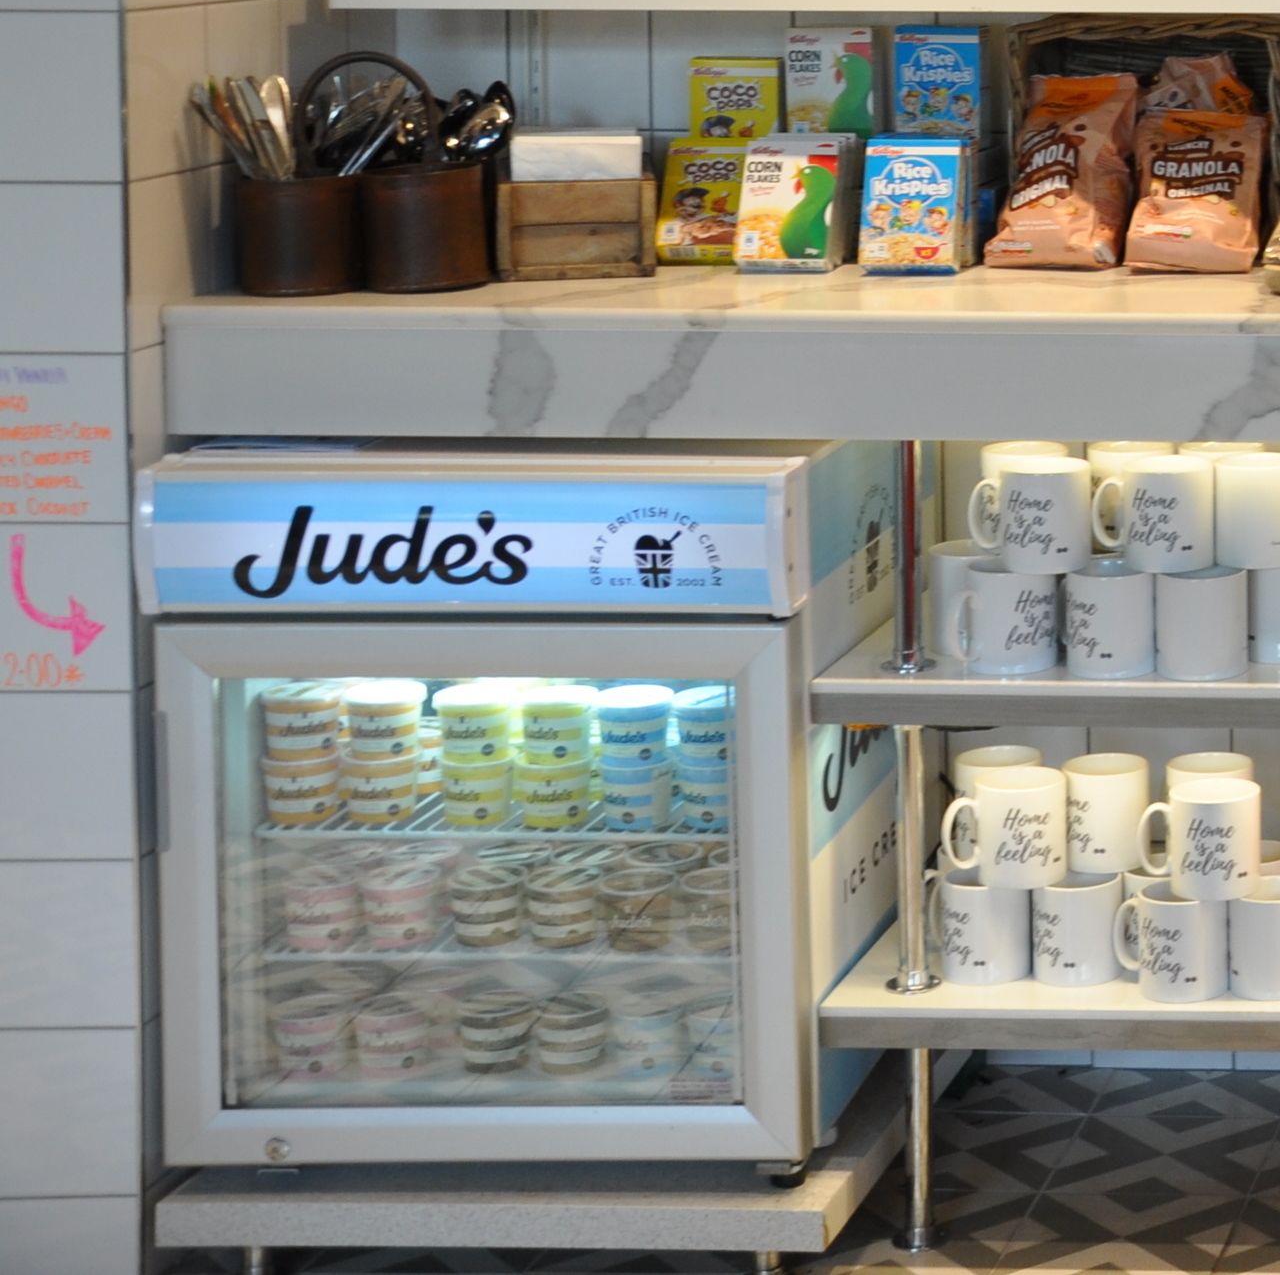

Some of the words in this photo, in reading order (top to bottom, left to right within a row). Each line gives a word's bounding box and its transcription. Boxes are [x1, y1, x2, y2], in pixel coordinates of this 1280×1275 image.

[788, 51, 822, 63] CORN
[920, 50, 955, 66] Rice
[788, 62, 822, 74] FLAKES
[902, 65, 974, 83] Krispies
[746, 160, 782, 174] CORN
[892, 161, 933, 179] Rice
[1153, 160, 1241, 179] GRANOLA
[746, 173, 782, 185] FLAKES
[872, 178, 952, 198] Krispies
[1167, 182, 1234, 198] ORIGINAL
[1007, 489, 1053, 513] Home
[1132, 488, 1178, 511] Home
[589, 534, 608, 586] GREAT
[606, 507, 670, 535] BRITISH
[672, 512, 699, 533] ICE
[698, 533, 723, 587] CREAM
[1003, 522, 1056, 555] feeling
[232, 504, 534, 599] Jude's
[1003, 807, 1050, 831] Home
[1187, 818, 1235, 841] Home
[994, 838, 1052, 866] feeling
[1180, 850, 1239, 881] feeling
